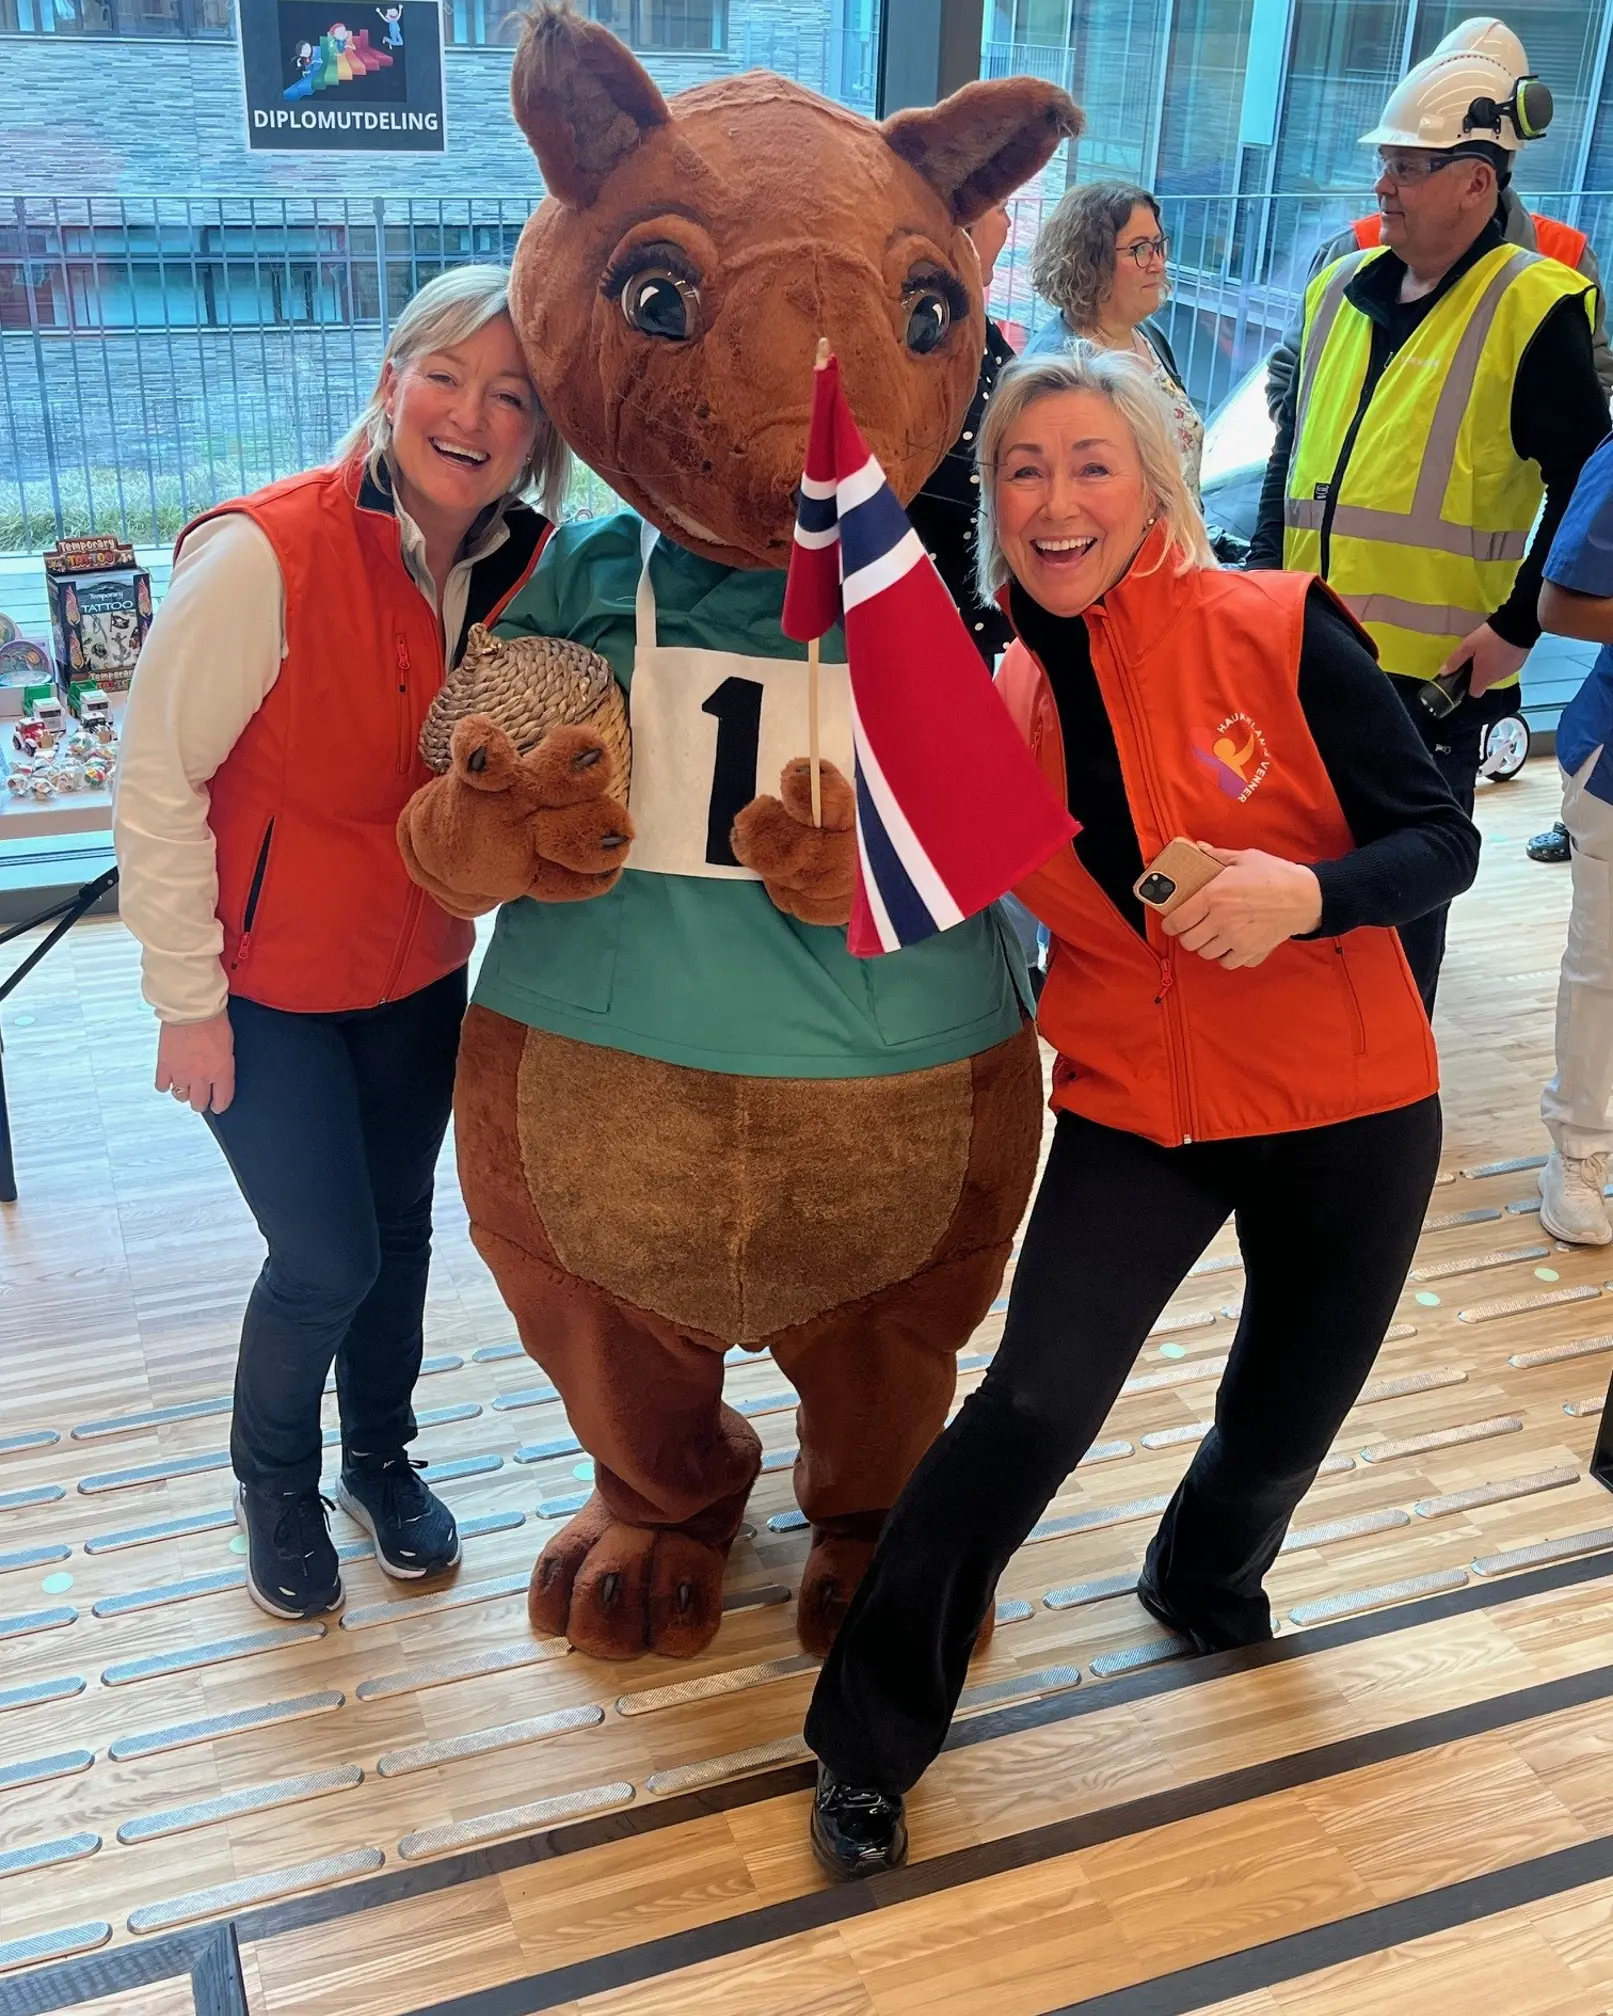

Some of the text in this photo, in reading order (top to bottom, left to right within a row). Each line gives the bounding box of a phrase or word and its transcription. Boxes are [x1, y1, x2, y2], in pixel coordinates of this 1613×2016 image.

[254, 110, 438, 130] DIPLOMUTDELING
[59, 539, 115, 552] Temporary
[89, 591, 124, 602] Temporary
[81, 600, 133, 613] TATTOO
[89, 669, 133, 682] Temporar
[702, 676, 764, 867] 1
[1237, 761, 1270, 803] VENNER
